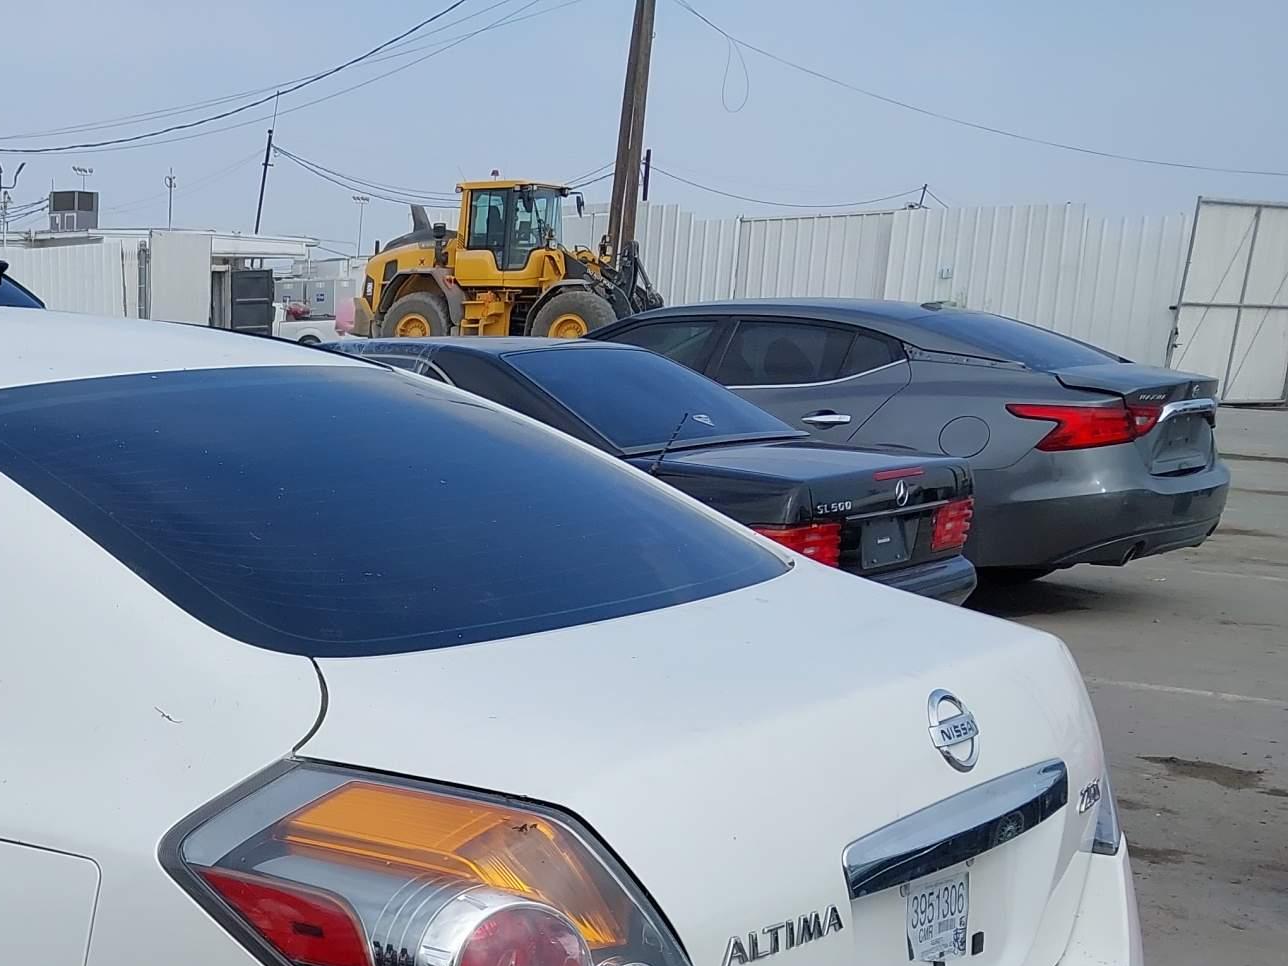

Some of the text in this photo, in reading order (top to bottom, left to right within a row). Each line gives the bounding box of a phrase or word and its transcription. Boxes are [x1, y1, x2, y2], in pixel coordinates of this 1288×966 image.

[817, 500, 852, 515] SL500
[940, 720, 976, 742] NISSA
[911, 881, 965, 929] 3951306
